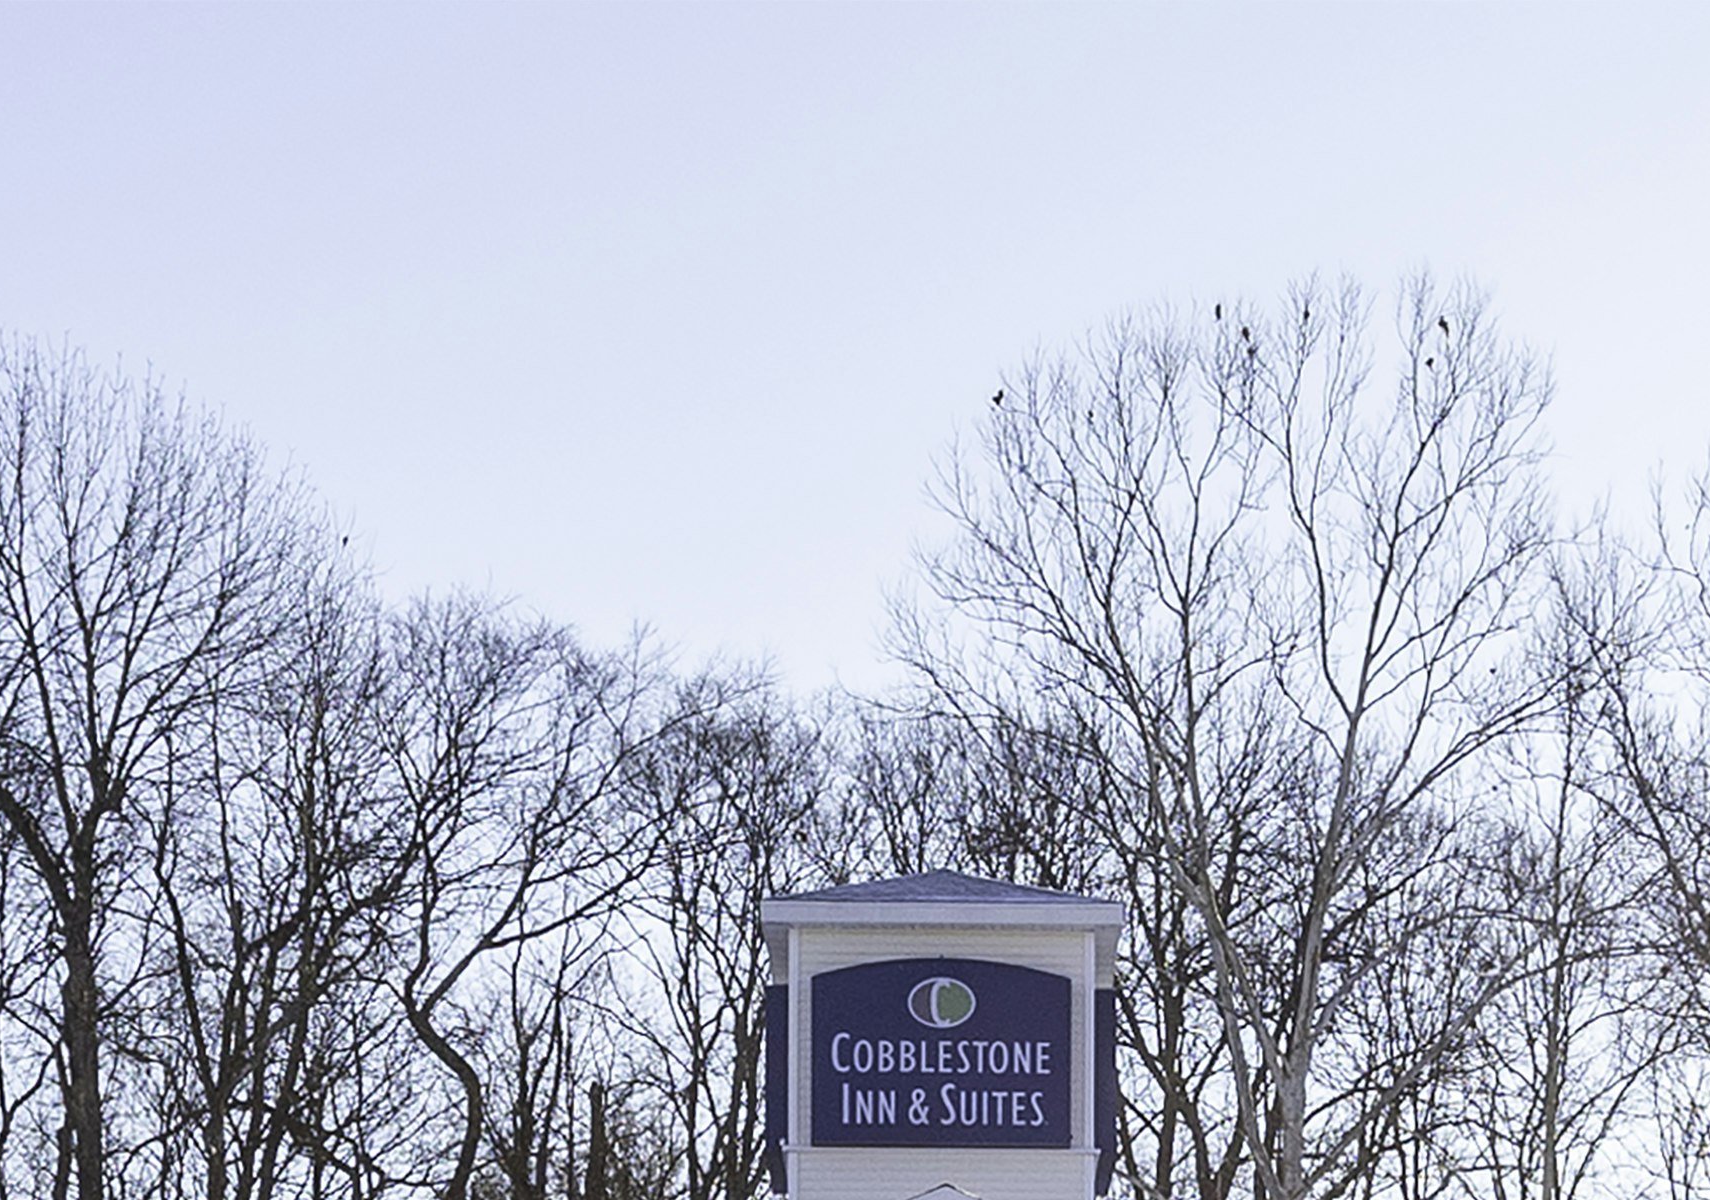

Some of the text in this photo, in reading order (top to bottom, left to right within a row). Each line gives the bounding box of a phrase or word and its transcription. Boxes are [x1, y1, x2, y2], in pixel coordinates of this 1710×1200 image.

[831, 1032, 1051, 1075] COBBLESTONE
[842, 1083, 1045, 1127] INN & SUITES
